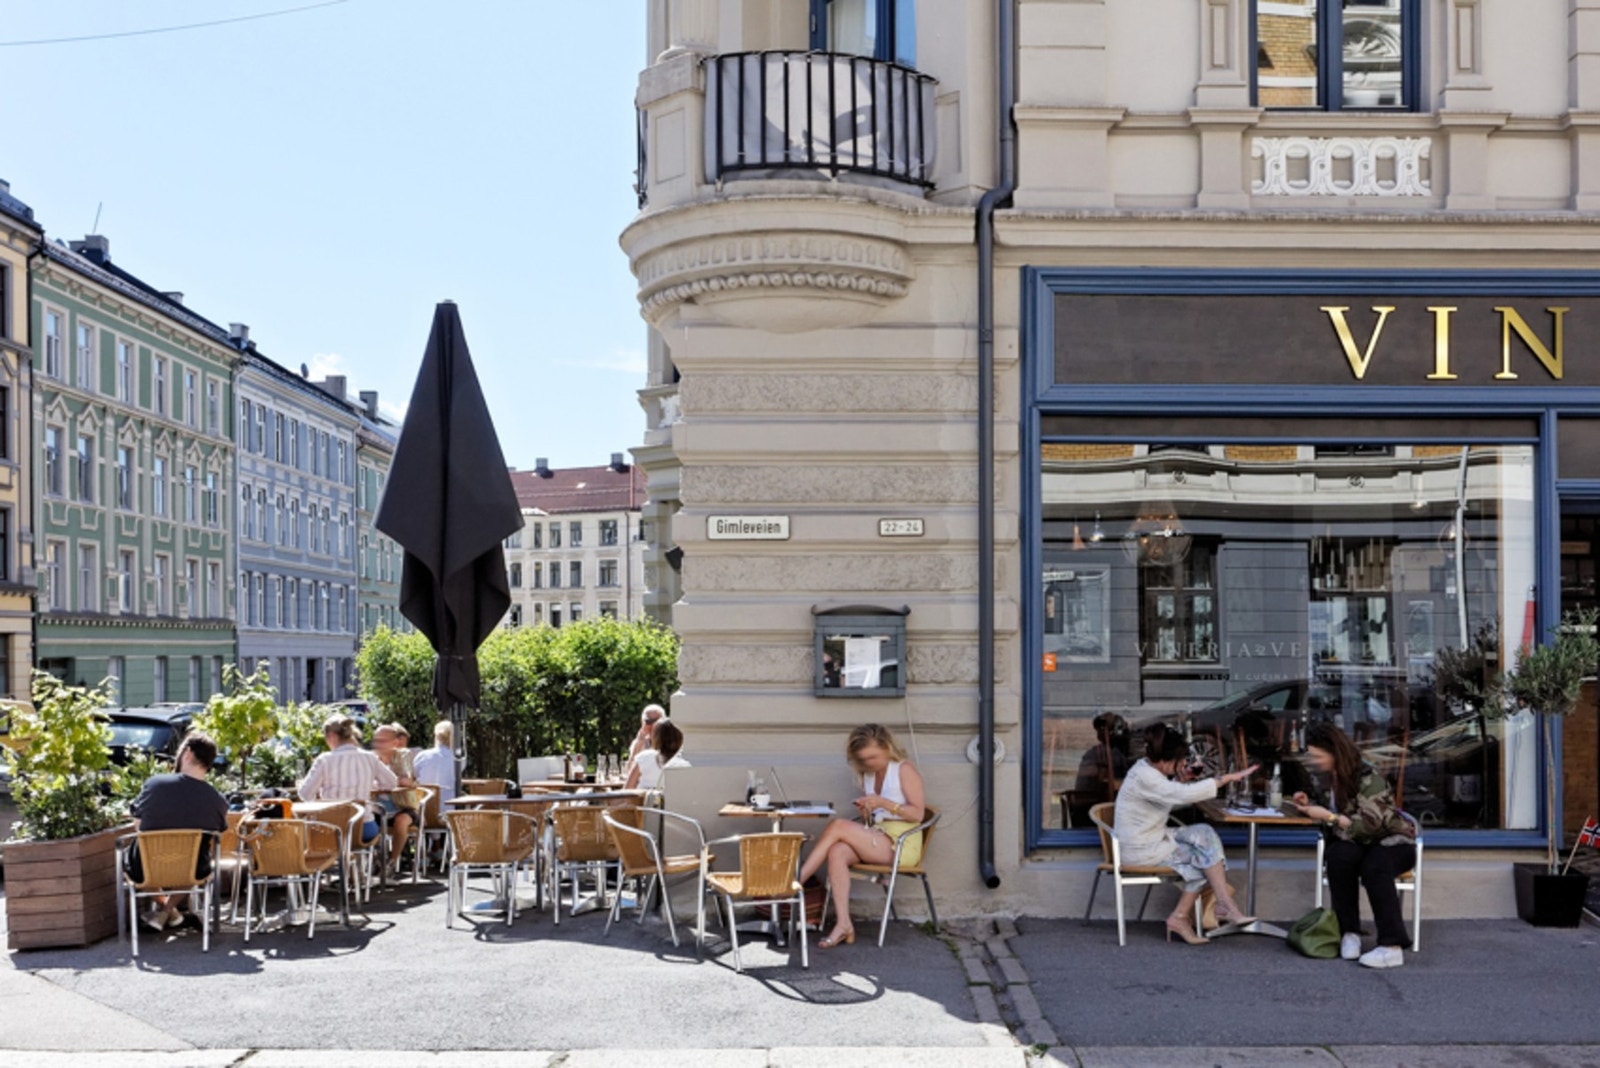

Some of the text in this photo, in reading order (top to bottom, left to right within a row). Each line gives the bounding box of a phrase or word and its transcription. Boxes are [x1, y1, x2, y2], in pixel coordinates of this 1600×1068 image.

[1319, 306, 1571, 379] VIN
[716, 519, 782, 535] Gimleveien
[884, 522, 919, 532] 22-24
[1133, 641, 1252, 658] VINERIA
